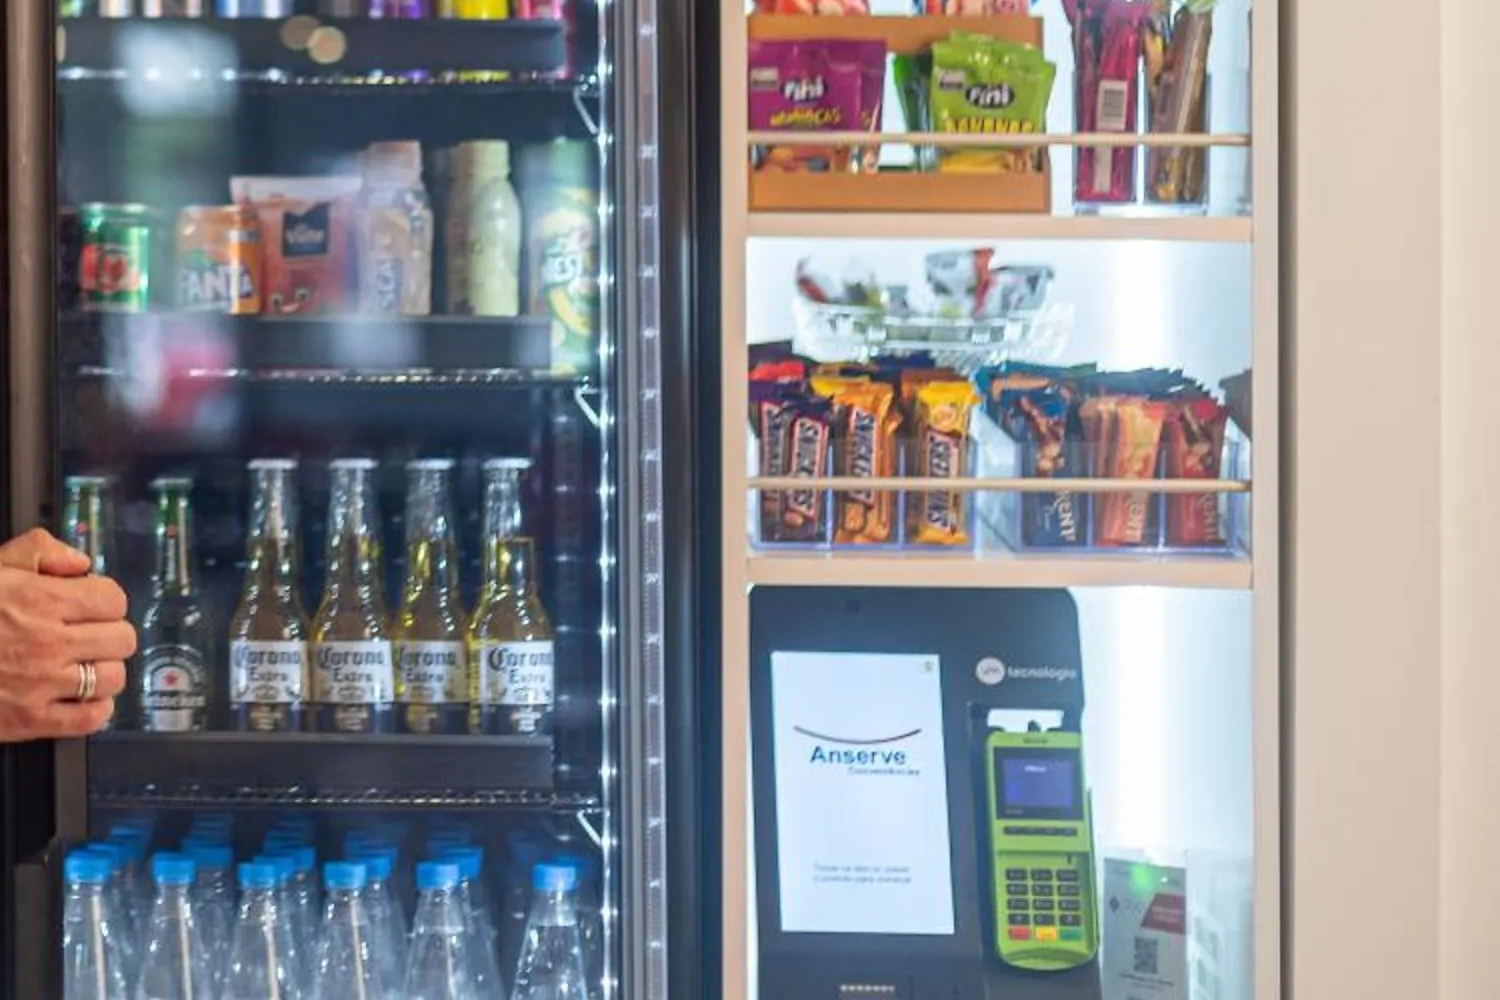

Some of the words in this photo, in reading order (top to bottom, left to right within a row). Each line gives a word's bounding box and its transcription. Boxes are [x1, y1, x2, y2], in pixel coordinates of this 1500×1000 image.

[968, 84, 1010, 107] Fini
[233, 646, 301, 670] Corona
[250, 668, 288, 682] Extra
[334, 668, 372, 682] Extra
[809, 745, 906, 765] Anserve
